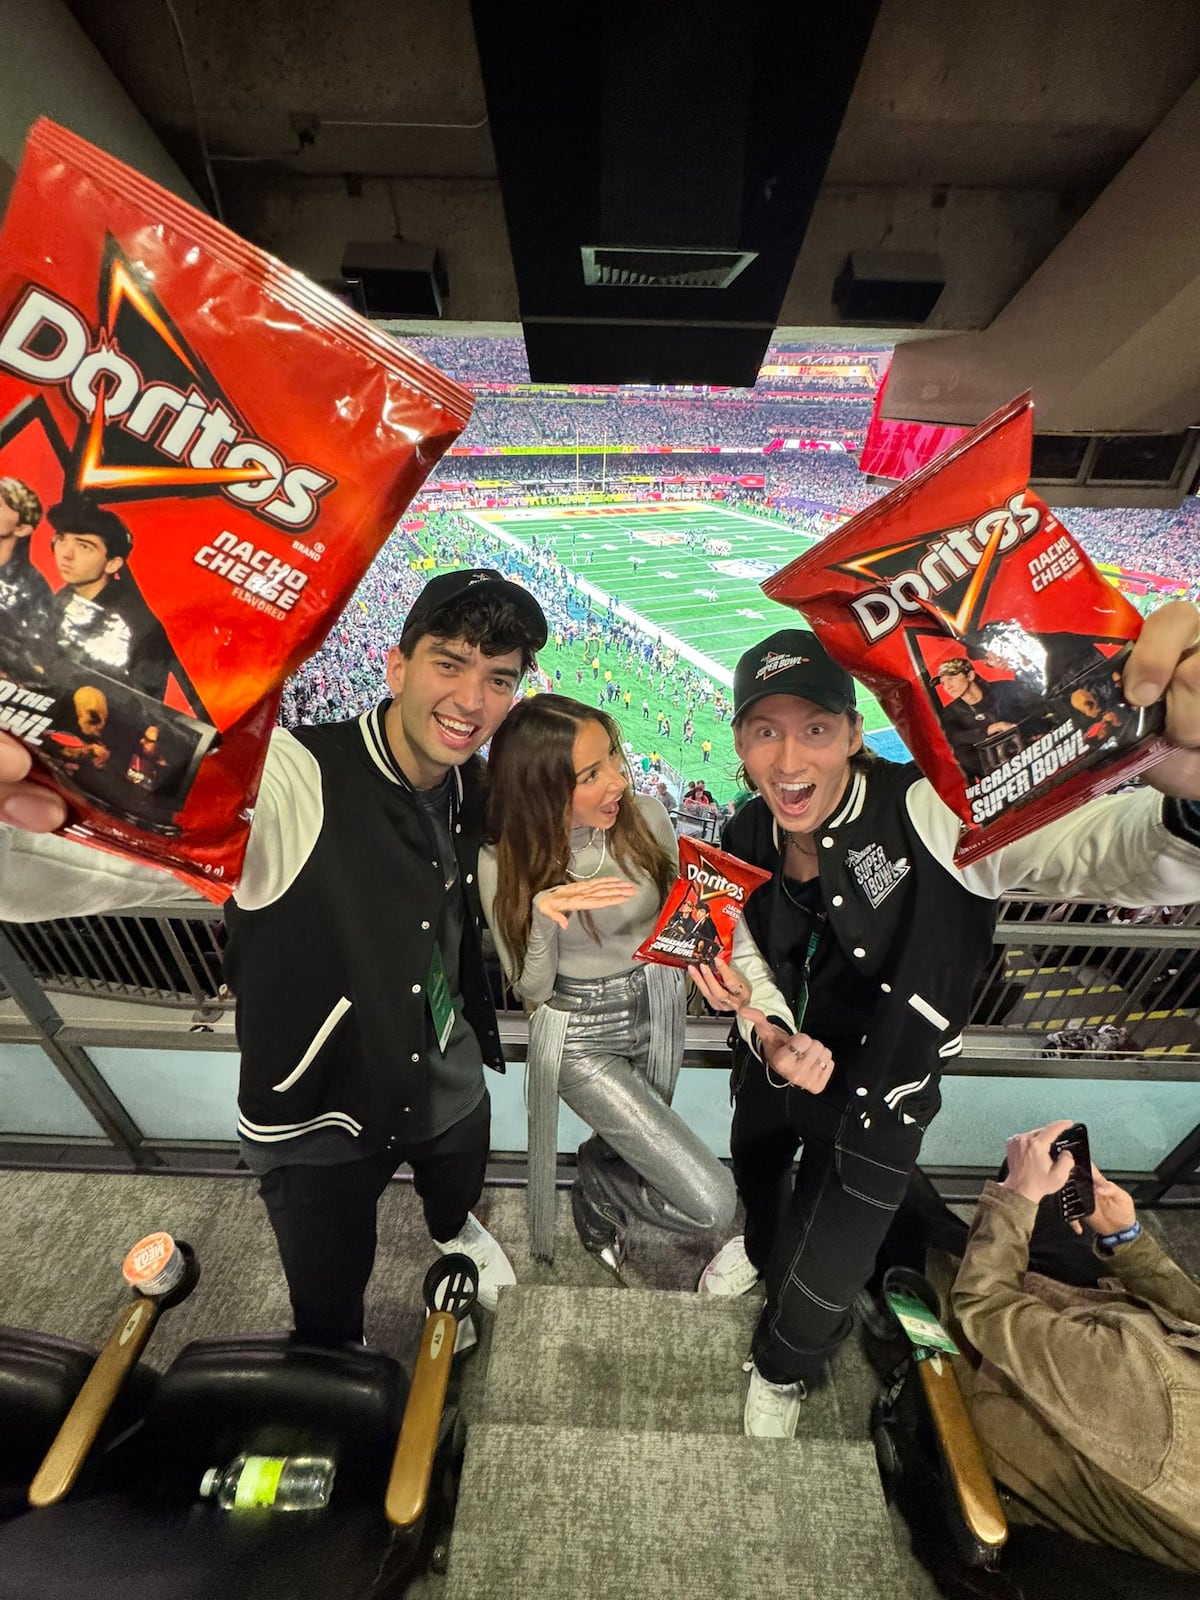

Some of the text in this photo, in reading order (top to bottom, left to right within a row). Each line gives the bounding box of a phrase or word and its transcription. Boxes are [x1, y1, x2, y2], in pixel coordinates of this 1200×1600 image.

[0, 289, 332, 526] Doritos
[212, 530, 308, 591] NACHO
[292, 540, 321, 562] BRAND
[852, 493, 1040, 641] Doritos
[1028, 536, 1071, 576] NACHO
[1031, 548, 1080, 593] CHEESE
[194, 545, 300, 611] CHEESE
[231, 586, 287, 621] FLAVORED
[11, 688, 56, 712] THE
[0, 706, 53, 746] WL
[965, 718, 1074, 799] WE CRASHED THE
[972, 729, 1090, 823] SUPER BOWL
[687, 864, 745, 901] Doritos
[854, 846, 887, 885] SUPER
